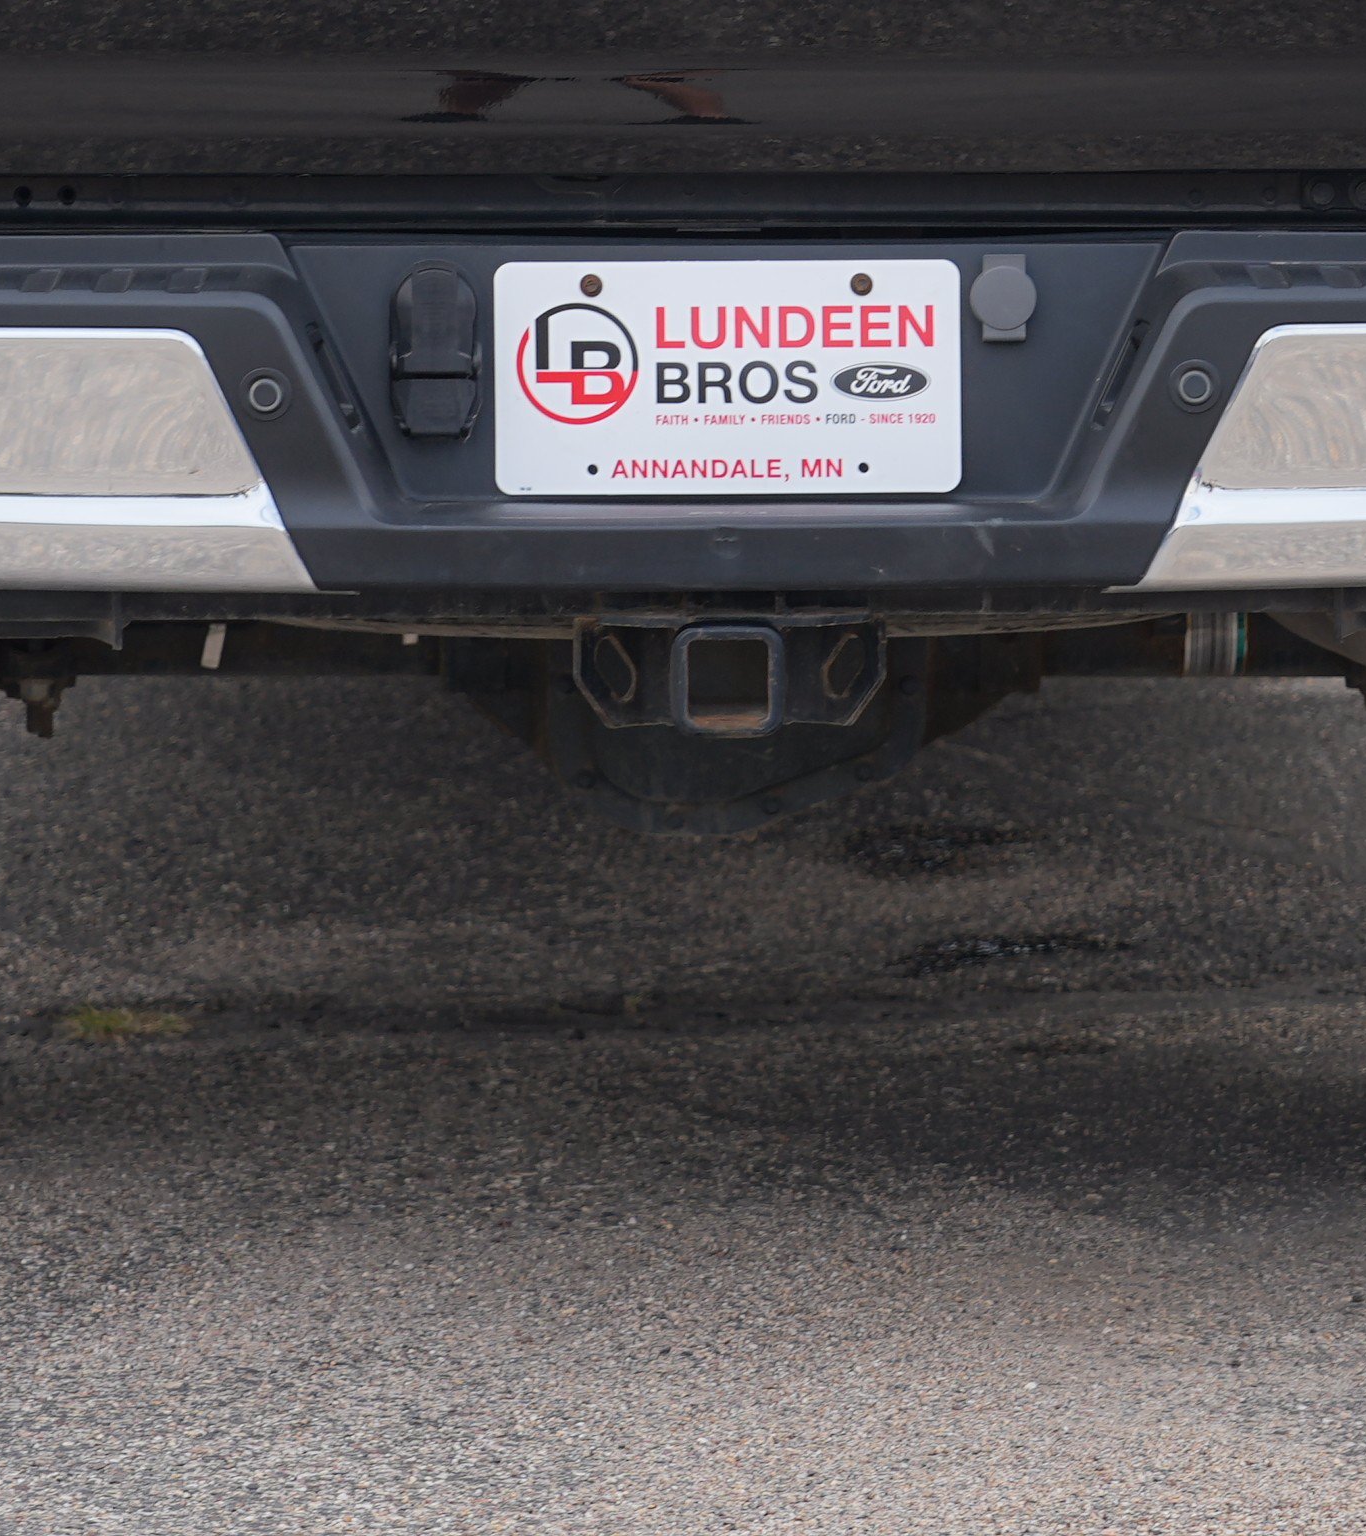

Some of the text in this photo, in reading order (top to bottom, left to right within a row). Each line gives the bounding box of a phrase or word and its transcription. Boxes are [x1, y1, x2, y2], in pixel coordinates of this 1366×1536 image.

[655, 305, 934, 349] LUNDEEN
[656, 361, 819, 405] BROS
[655, 413, 936, 425] FAITH FAMILY FRIENDS FORD SINCE 1920
[611, 458, 844, 482] ANNANDALE, MN
